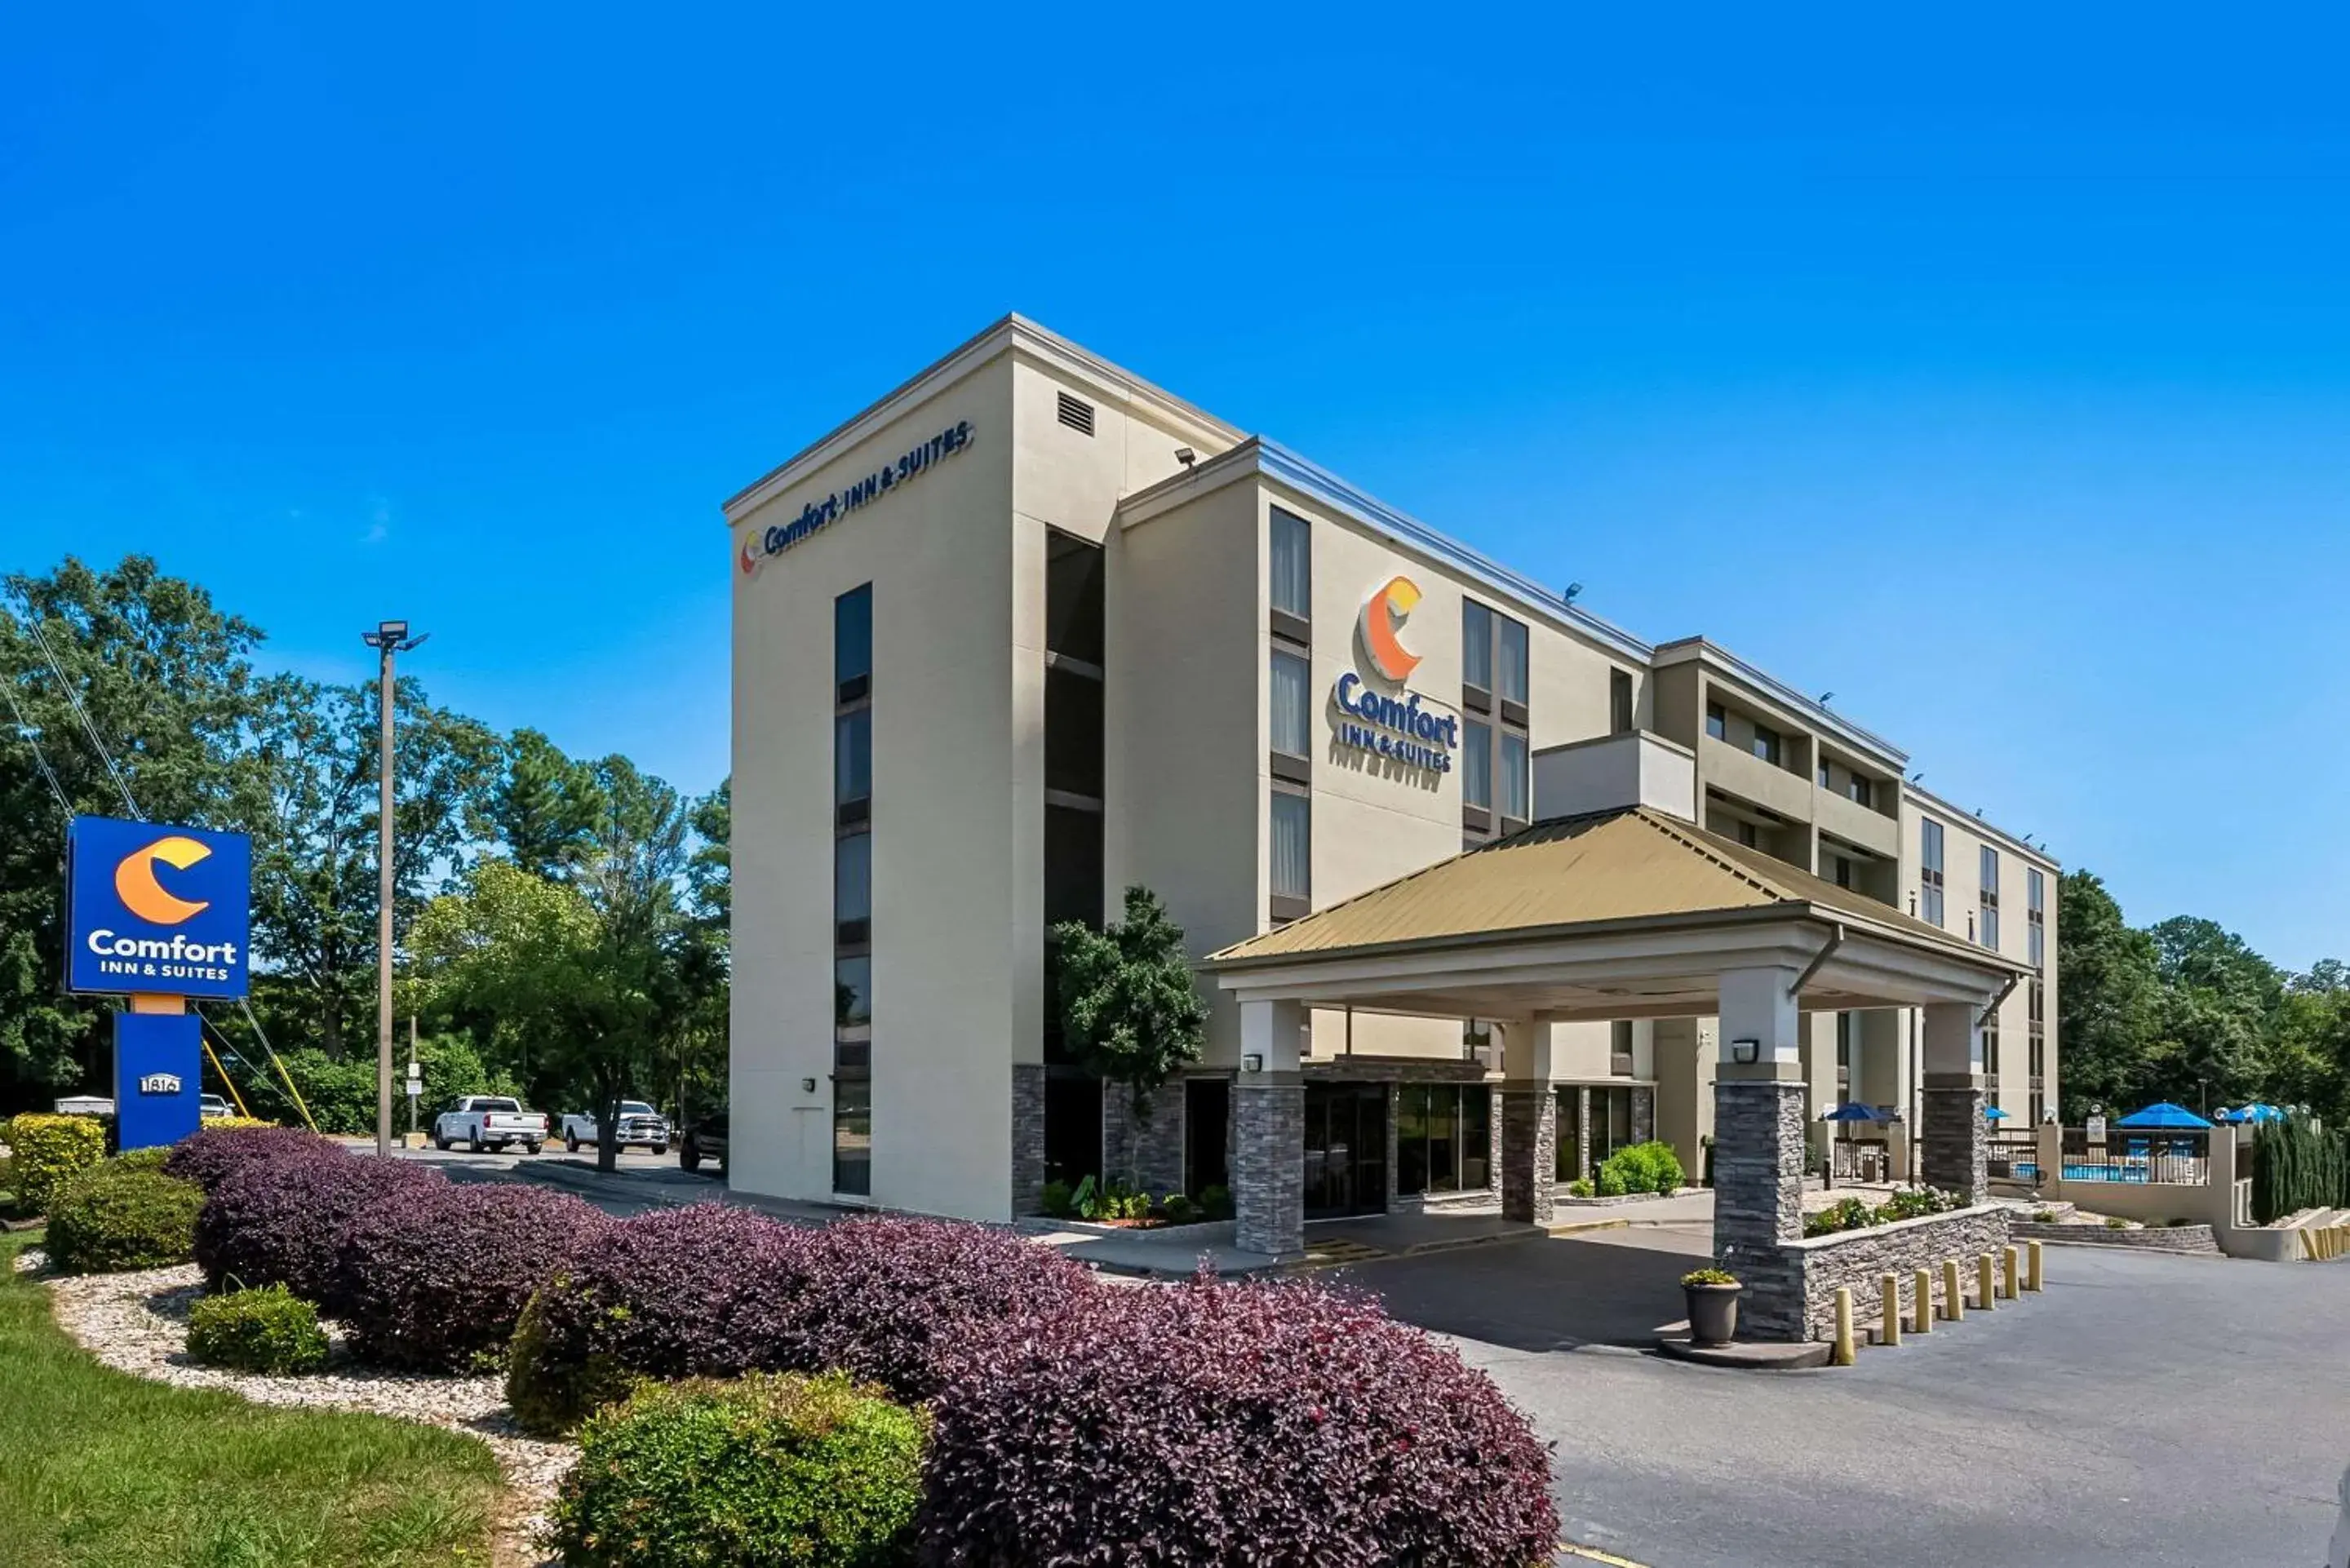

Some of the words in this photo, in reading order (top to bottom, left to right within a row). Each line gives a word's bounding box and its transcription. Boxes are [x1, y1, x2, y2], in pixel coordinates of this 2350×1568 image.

[765, 493, 837, 555] Comfort
[844, 473, 876, 511] INN
[881, 465, 894, 489] &
[898, 420, 968, 480] SUITES
[1339, 672, 1458, 749] Comfort
[1342, 721, 1374, 751] INN
[1380, 734, 1391, 754] &
[1394, 739, 1451, 773] SUITES
[88, 929, 237, 964] Comfort
[100, 960, 137, 974] INN
[144, 963, 155, 976] &
[162, 965, 228, 981] SUITES
[147, 1079, 176, 1092] 1816
